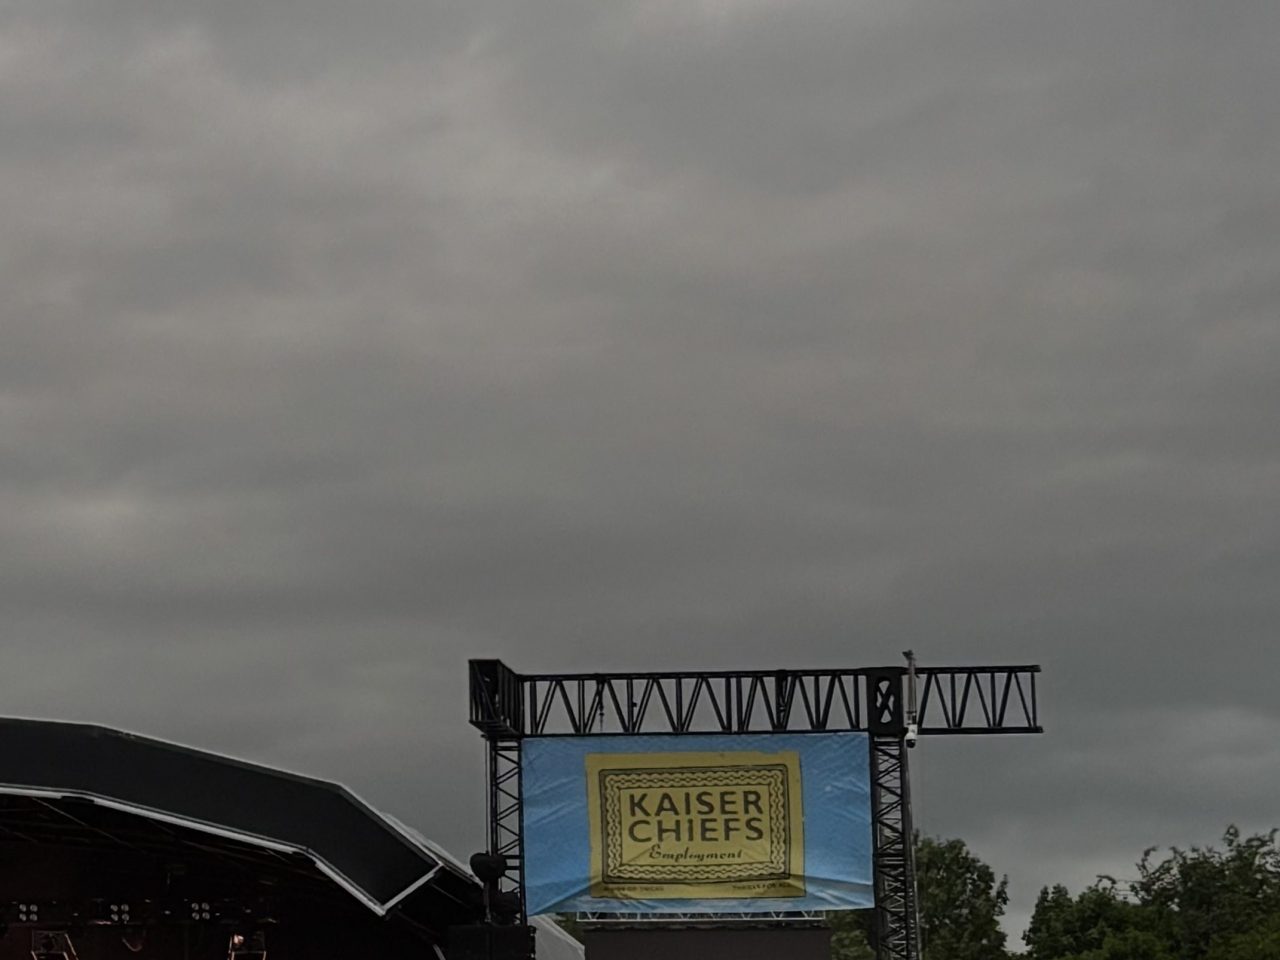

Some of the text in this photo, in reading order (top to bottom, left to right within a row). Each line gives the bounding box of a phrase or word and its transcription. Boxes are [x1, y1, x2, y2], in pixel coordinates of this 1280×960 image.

[629, 790, 764, 818] KAISER
[628, 817, 764, 843] CHIEFS
[648, 843, 743, 862] Employment
